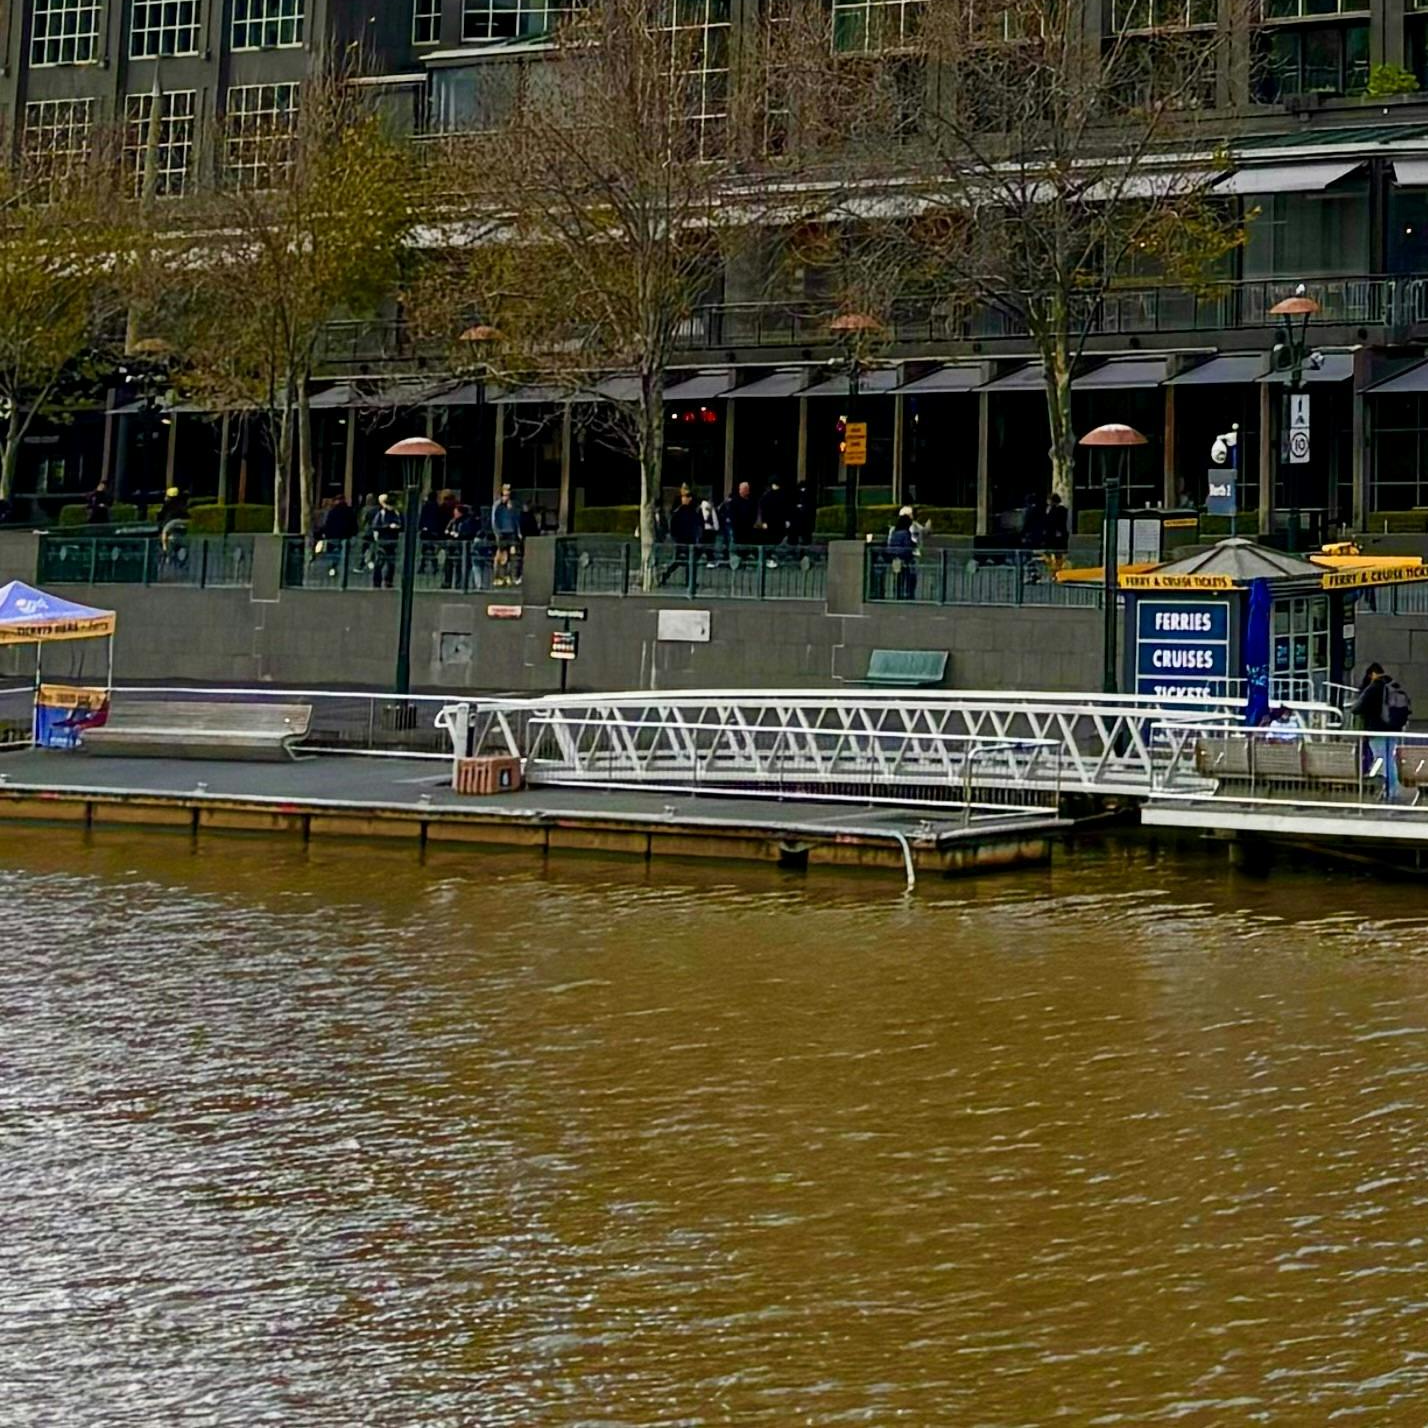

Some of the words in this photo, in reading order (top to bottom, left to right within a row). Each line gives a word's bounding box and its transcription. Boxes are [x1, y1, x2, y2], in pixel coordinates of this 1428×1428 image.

[1295, 439, 1305, 450] 10
[1126, 576, 1150, 586] FERRY
[1162, 576, 1191, 587] CRUISE
[1194, 576, 1227, 587] TICKETS
[1329, 573, 1357, 586] FERRY
[1361, 572, 1368, 583] &
[1371, 568, 1403, 581] CRUISE
[1155, 612, 1212, 631] FERRIES
[1152, 649, 1213, 669] CRUISES
